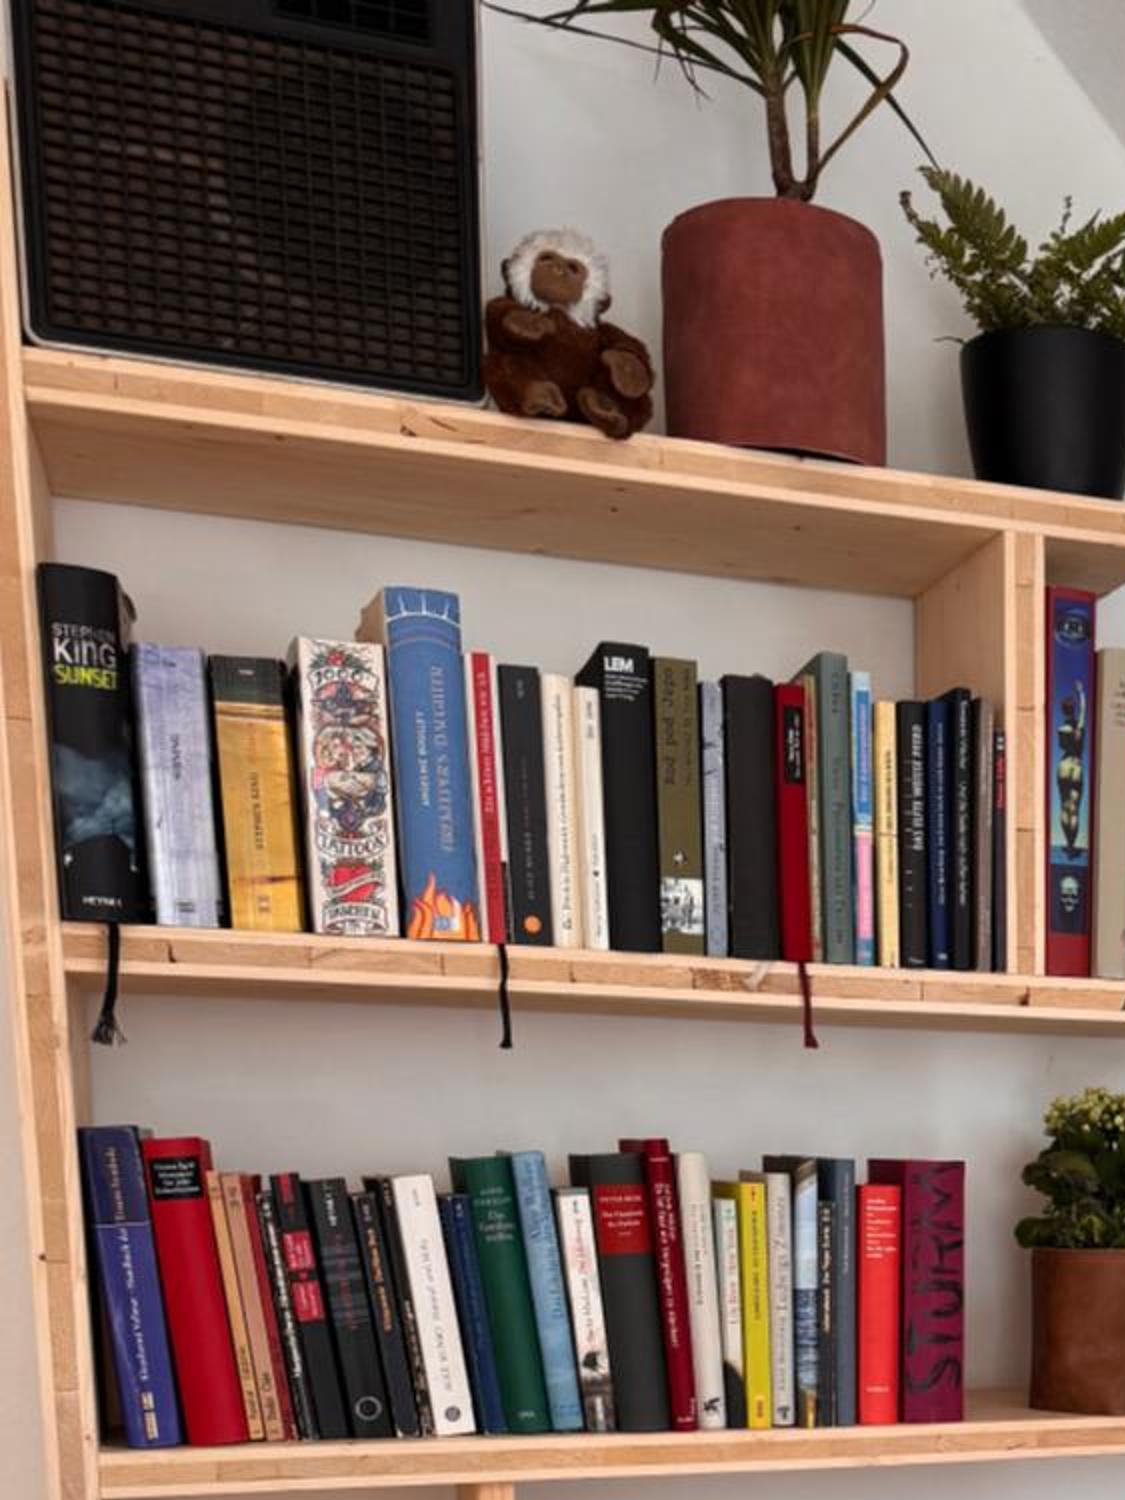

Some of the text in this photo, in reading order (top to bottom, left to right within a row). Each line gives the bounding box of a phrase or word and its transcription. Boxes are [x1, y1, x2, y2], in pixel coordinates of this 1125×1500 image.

[54, 637, 117, 668] KING
[603, 656, 634, 673] LEM
[54, 663, 117, 690] SUNSET
[908, 1162, 964, 1393] STURM
